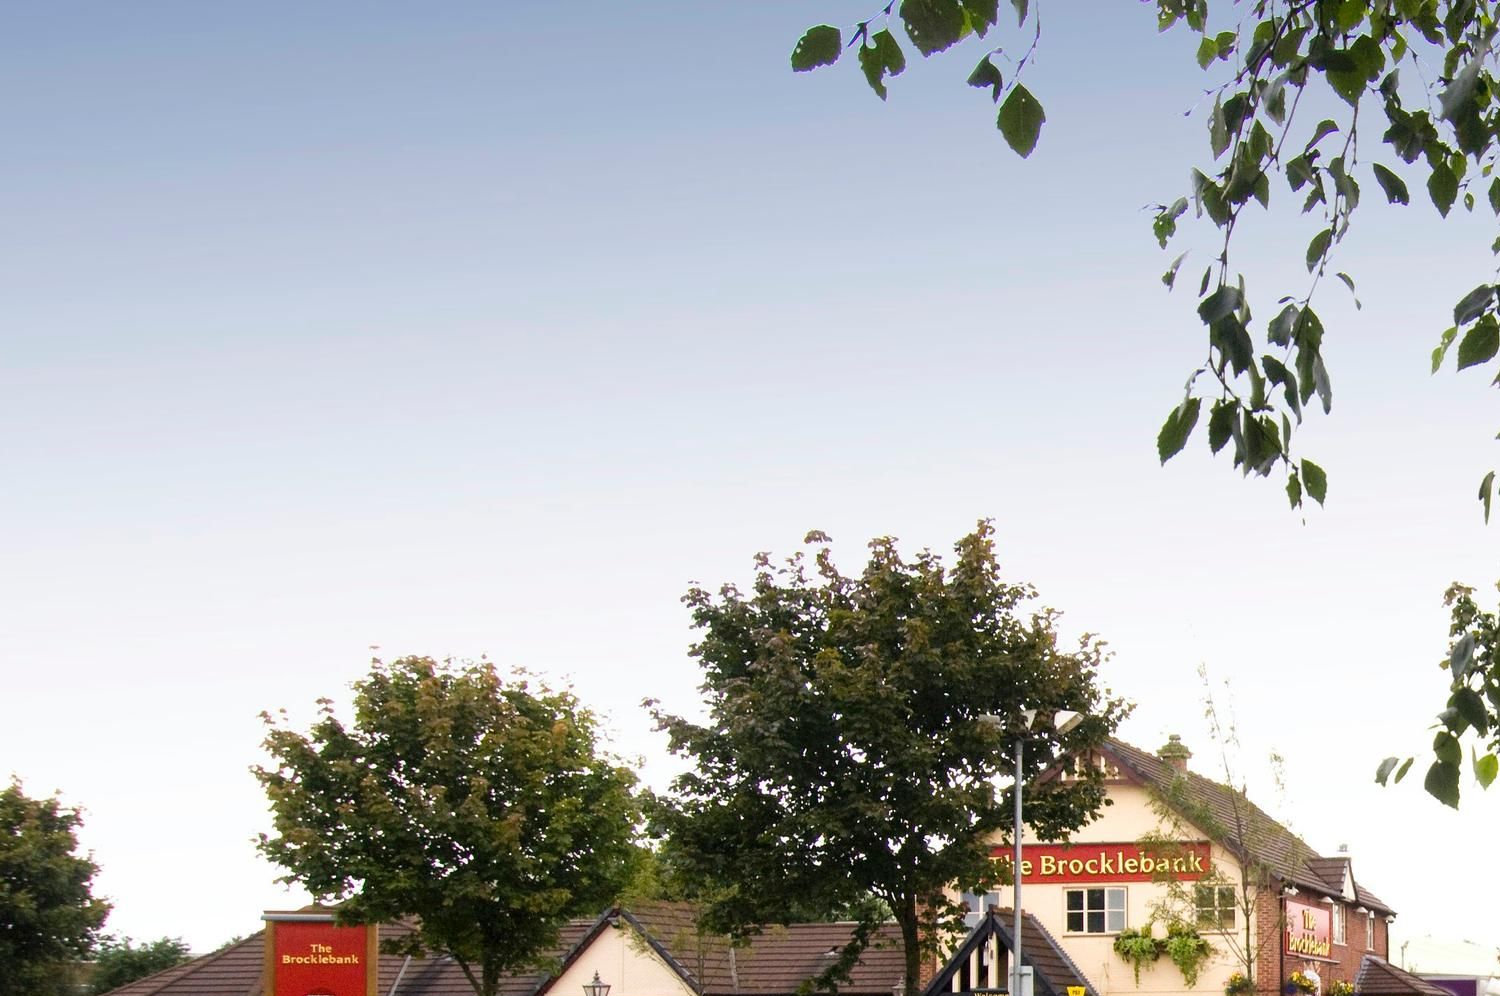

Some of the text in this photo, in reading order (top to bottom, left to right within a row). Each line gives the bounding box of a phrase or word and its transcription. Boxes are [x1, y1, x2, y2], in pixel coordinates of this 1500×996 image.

[1040, 850, 1204, 876] Brocklebank
[1302, 910, 1316, 930] The
[310, 943, 332, 953] The
[282, 954, 359, 964] Brocklebank
